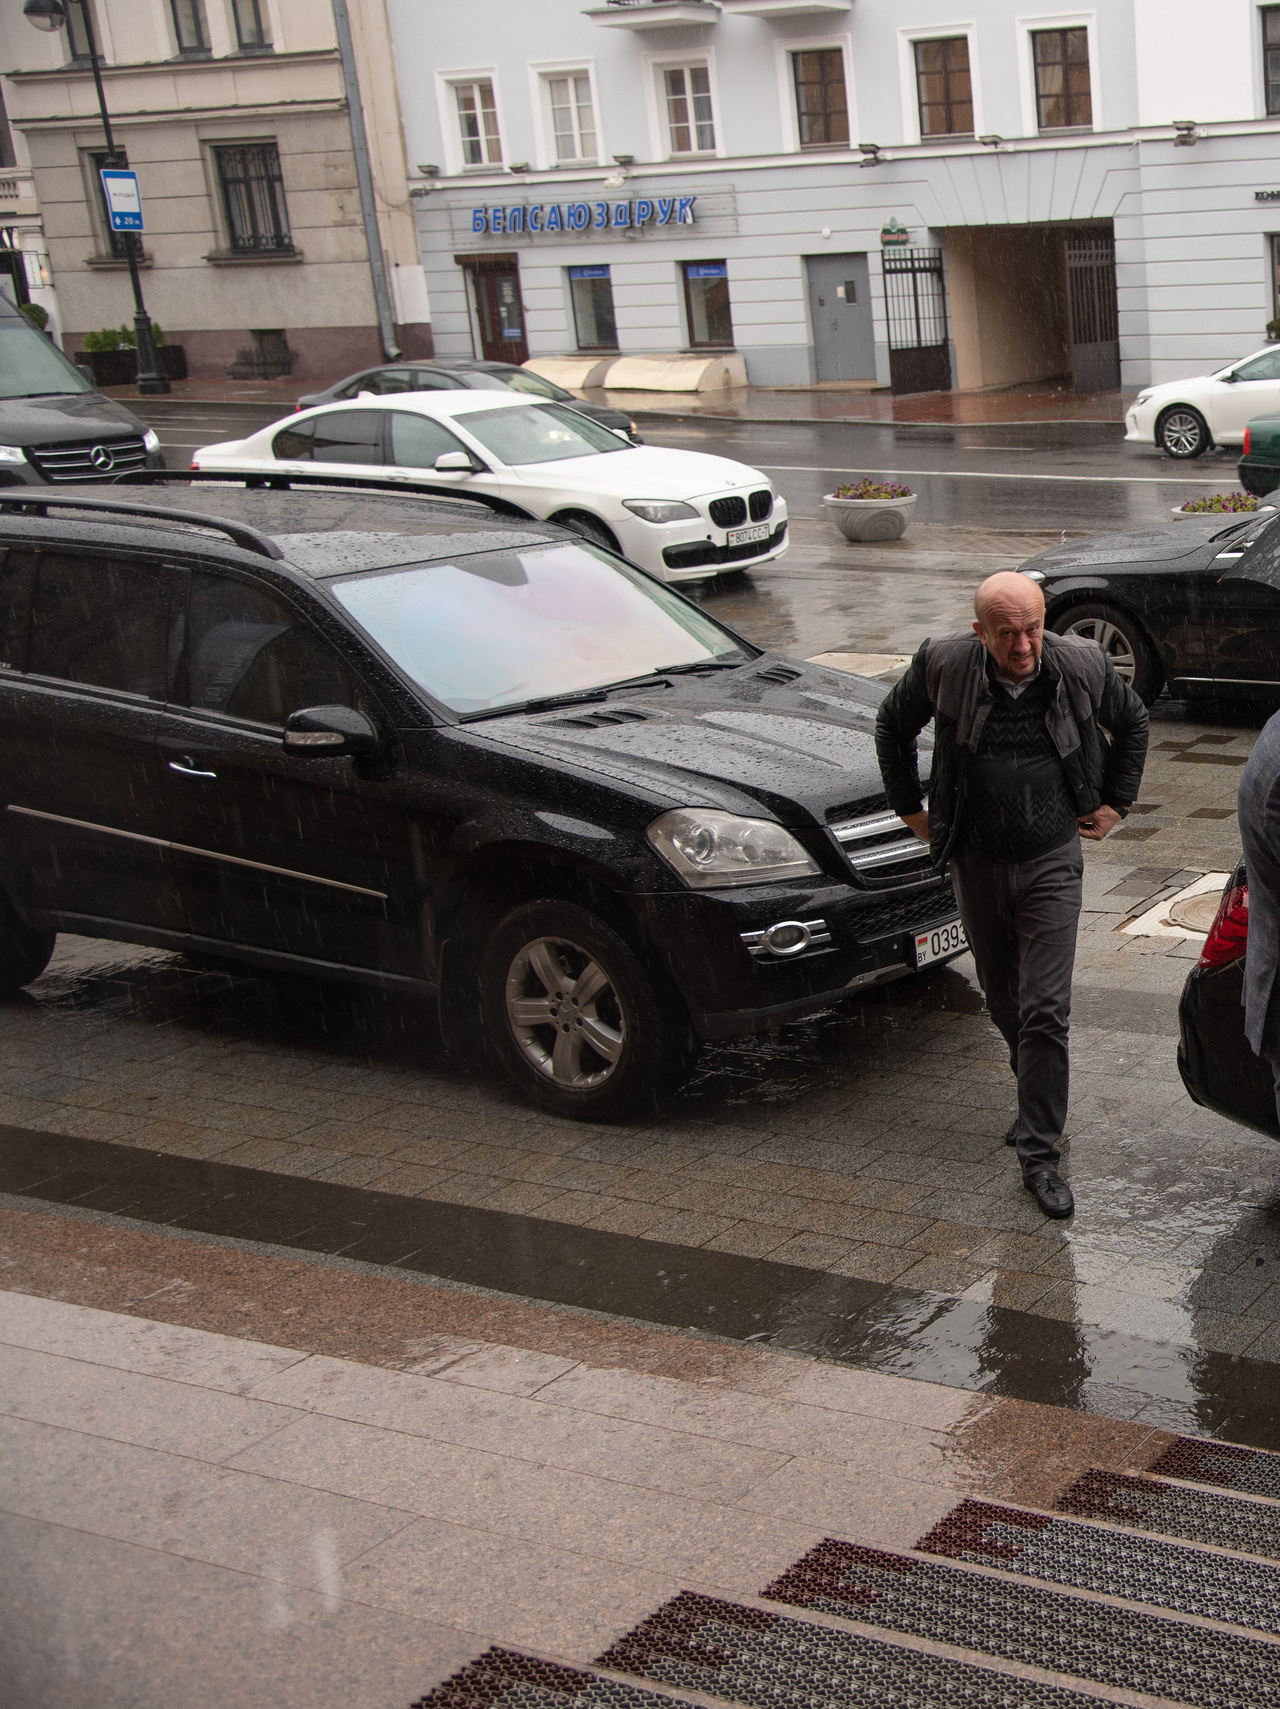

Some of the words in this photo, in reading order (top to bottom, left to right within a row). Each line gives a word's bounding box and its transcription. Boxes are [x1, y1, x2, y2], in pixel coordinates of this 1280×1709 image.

[123, 216, 134, 225] 20
[472, 197, 697, 234] БЕЛСАЮЗДРУК
[917, 950, 927, 963] BY
